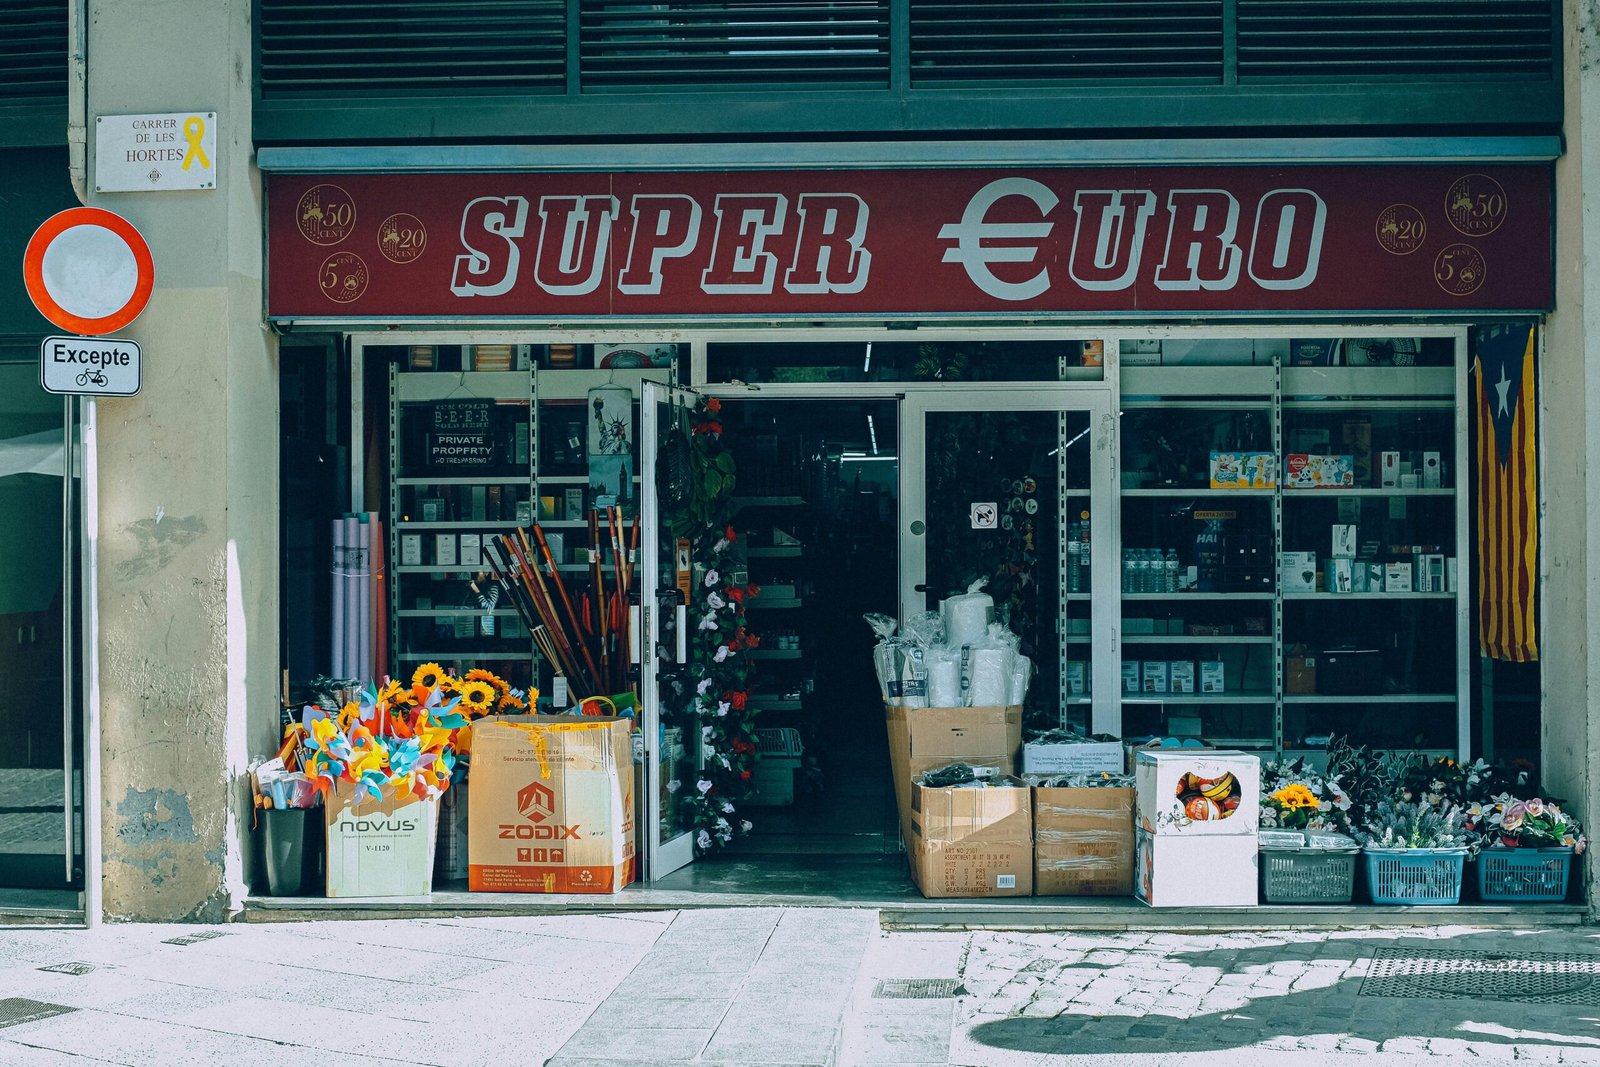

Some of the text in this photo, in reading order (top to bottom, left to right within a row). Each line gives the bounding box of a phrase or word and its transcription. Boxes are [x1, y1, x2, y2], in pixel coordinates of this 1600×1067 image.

[132, 119, 177, 130] CARRER
[135, 132, 175, 144] DE LES
[126, 148, 184, 162] HORTES
[1472, 193, 1502, 217] 50
[323, 203, 352, 227] 50
[319, 229, 345, 238] CENT
[1398, 219, 1424, 239] 20
[1469, 220, 1493, 229] CENT
[399, 228, 424, 248] 20
[450, 177, 1328, 301] SUPER €URO
[1395, 241, 1416, 249] CENT
[321, 262, 338, 289] 5
[1437, 254, 1454, 281] 5
[53, 344, 130, 369] Excepte
[438, 436, 484, 444] PRIVATE
[498, 824, 582, 840] ZODIX
